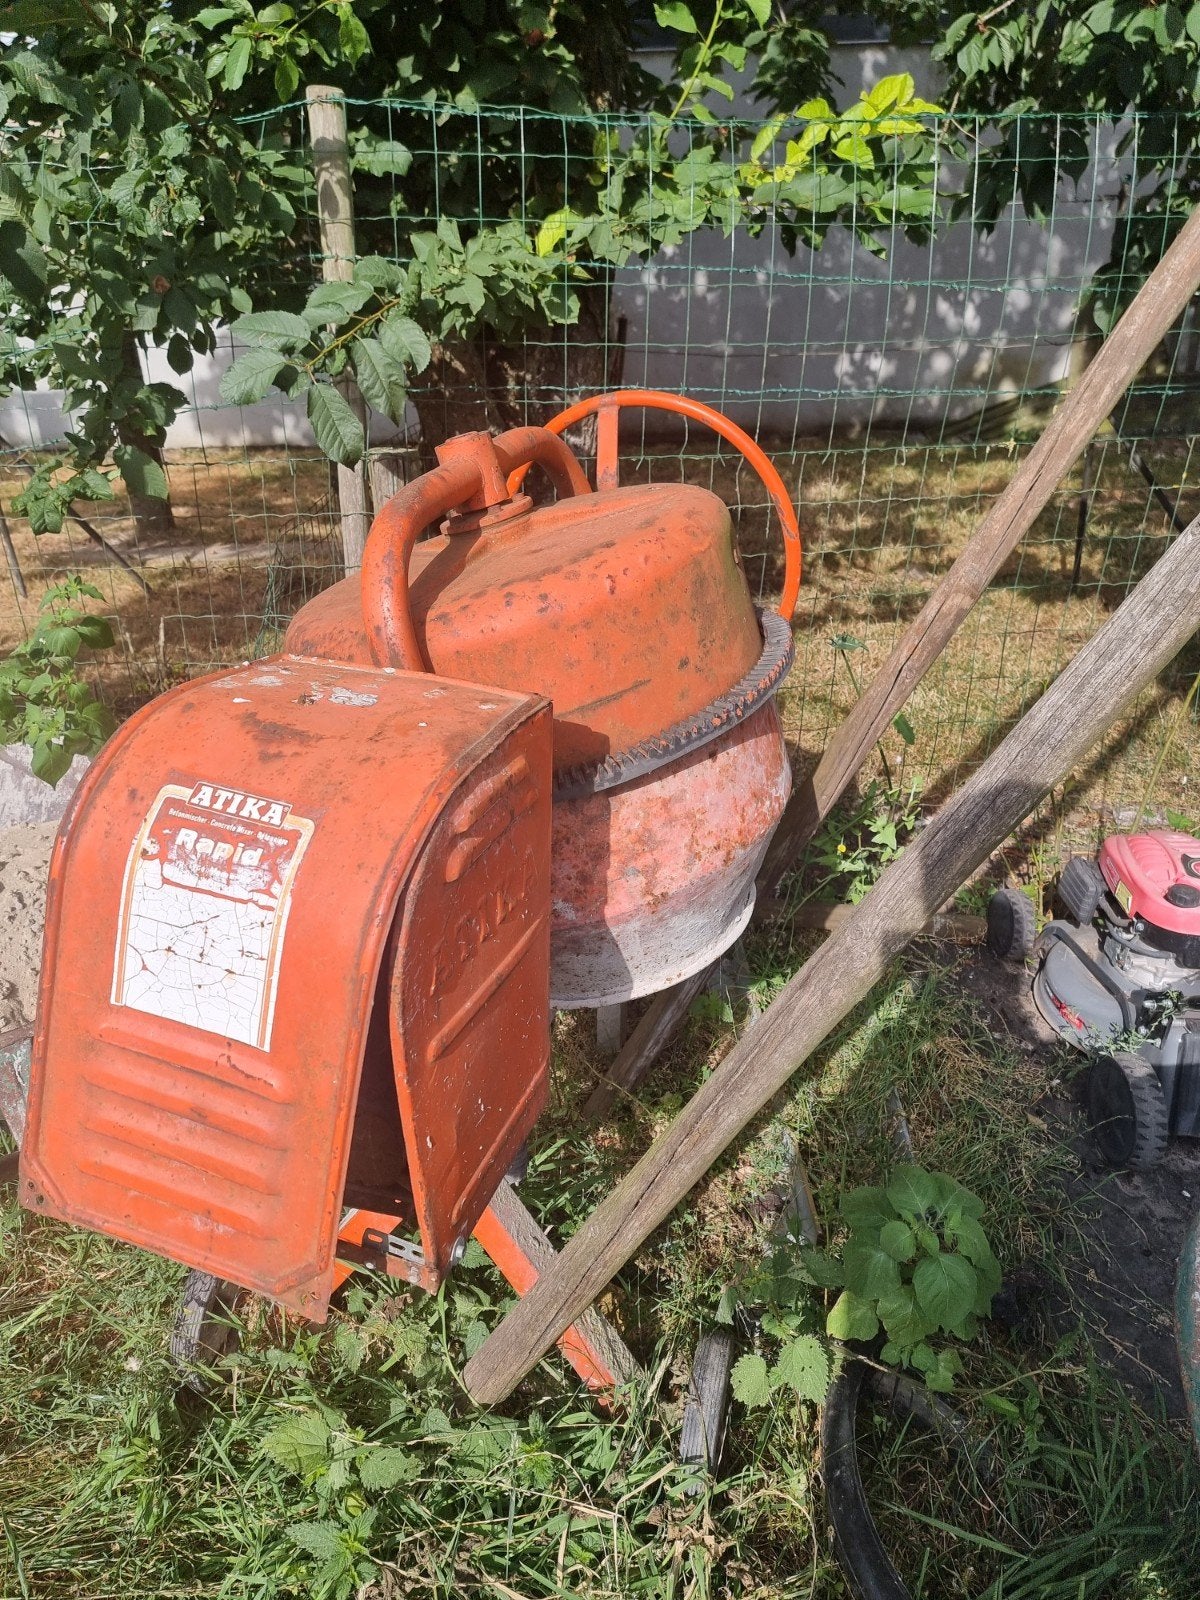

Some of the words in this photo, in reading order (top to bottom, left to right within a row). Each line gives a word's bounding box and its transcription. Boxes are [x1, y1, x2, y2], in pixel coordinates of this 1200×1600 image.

[191, 785, 283, 825] ATIKA
[210, 819, 236, 832] Concrete
[175, 827, 264, 866] Rapid
